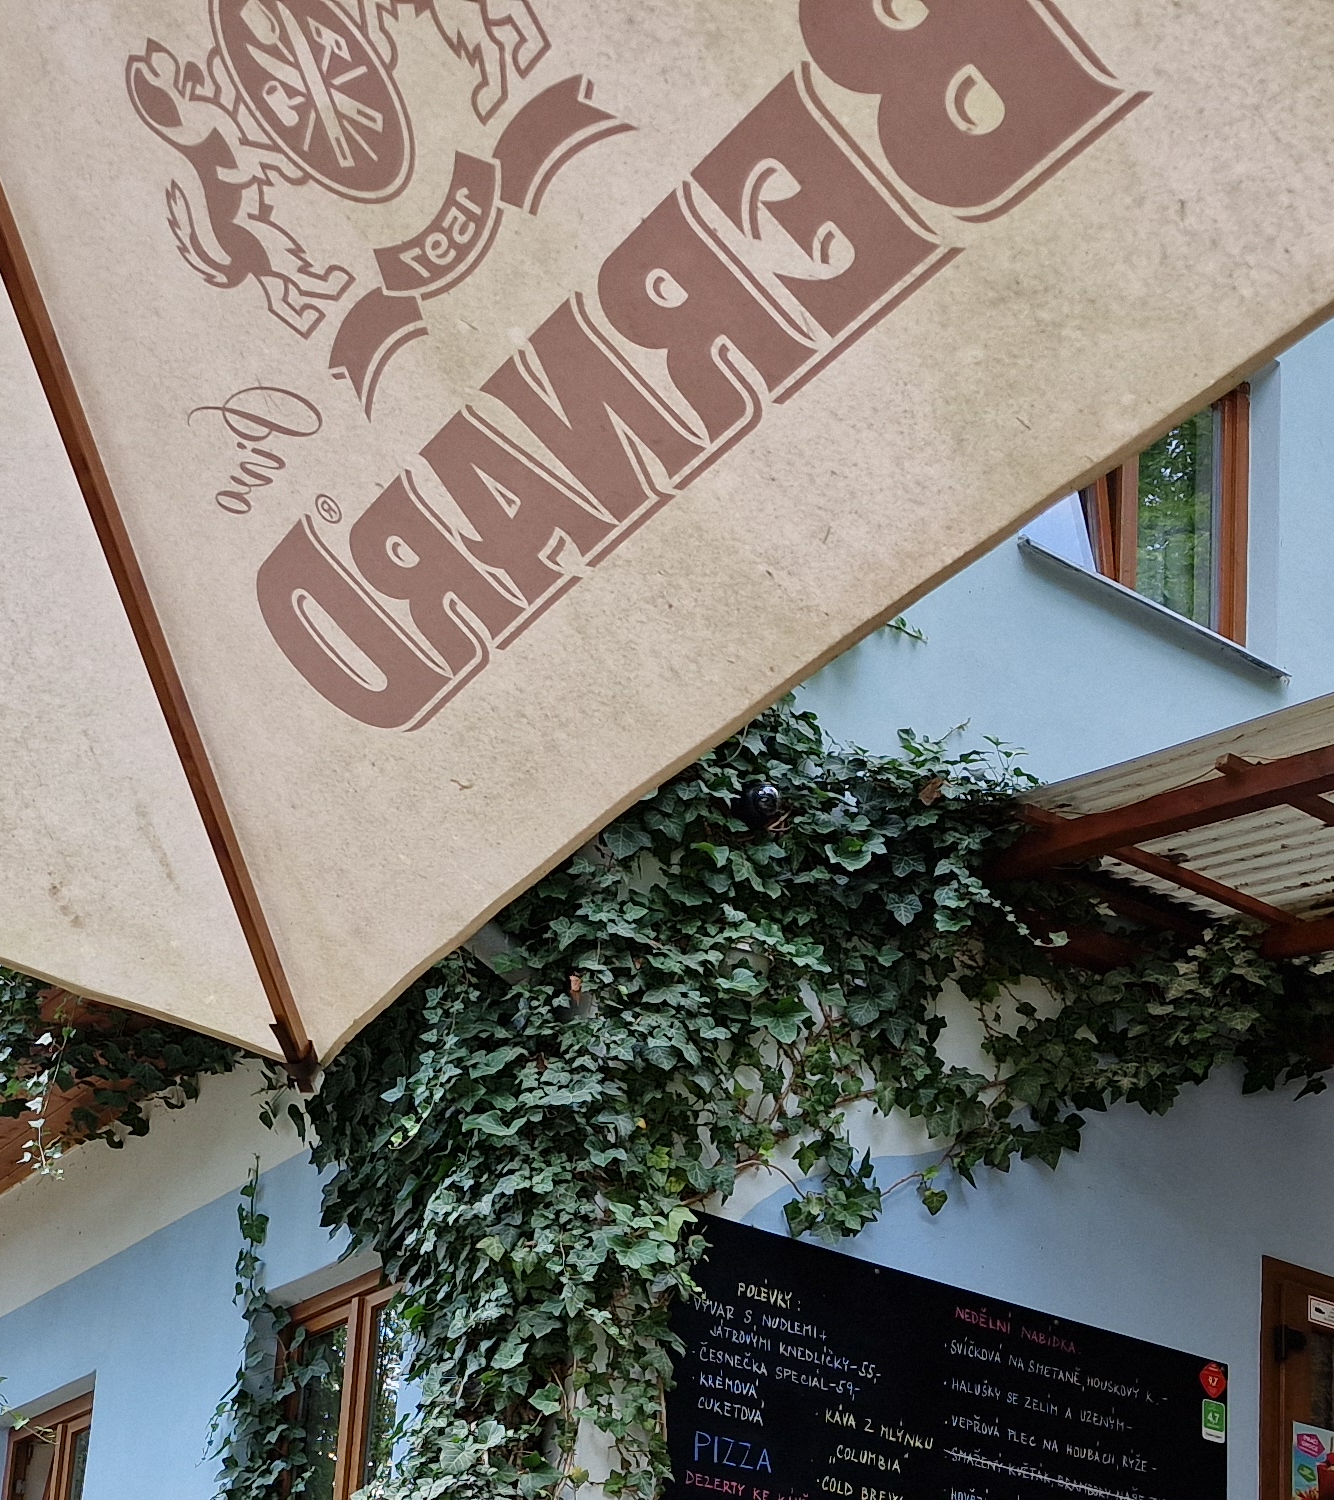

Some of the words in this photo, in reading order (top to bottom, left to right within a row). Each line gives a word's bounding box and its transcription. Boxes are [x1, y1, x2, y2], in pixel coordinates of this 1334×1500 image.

[744, 1309, 753, 1324] S
[954, 1305, 1012, 1335] NEDĚLNÍ
[699, 1341, 767, 1376] ČESNEČKA
[950, 1337, 1003, 1364] SVÍČKOVÁ
[1008, 1355, 1025, 1372] NA
[699, 1369, 759, 1399] KRÉMOVÁ
[951, 1377, 1001, 1401] HALUŠKY
[1007, 1391, 1019, 1405] SE
[1024, 1393, 1058, 1416] ZELÍM
[1065, 1407, 1072, 1420] A
[698, 1396, 764, 1426] CUKETOVÁ
[825, 1404, 856, 1430] KÁVA
[864, 1419, 874, 1433] Z
[880, 1417, 934, 1450] MLÝNKU
[951, 1415, 1000, 1438] VEPŘOVÁ
[1007, 1428, 1037, 1447] PLEC
[1042, 1438, 1059, 1454] NA
[694, 1430, 772, 1474] PIZZA
[685, 1469, 745, 1497] DEZERTY
[821, 1475, 853, 1496] COLD
